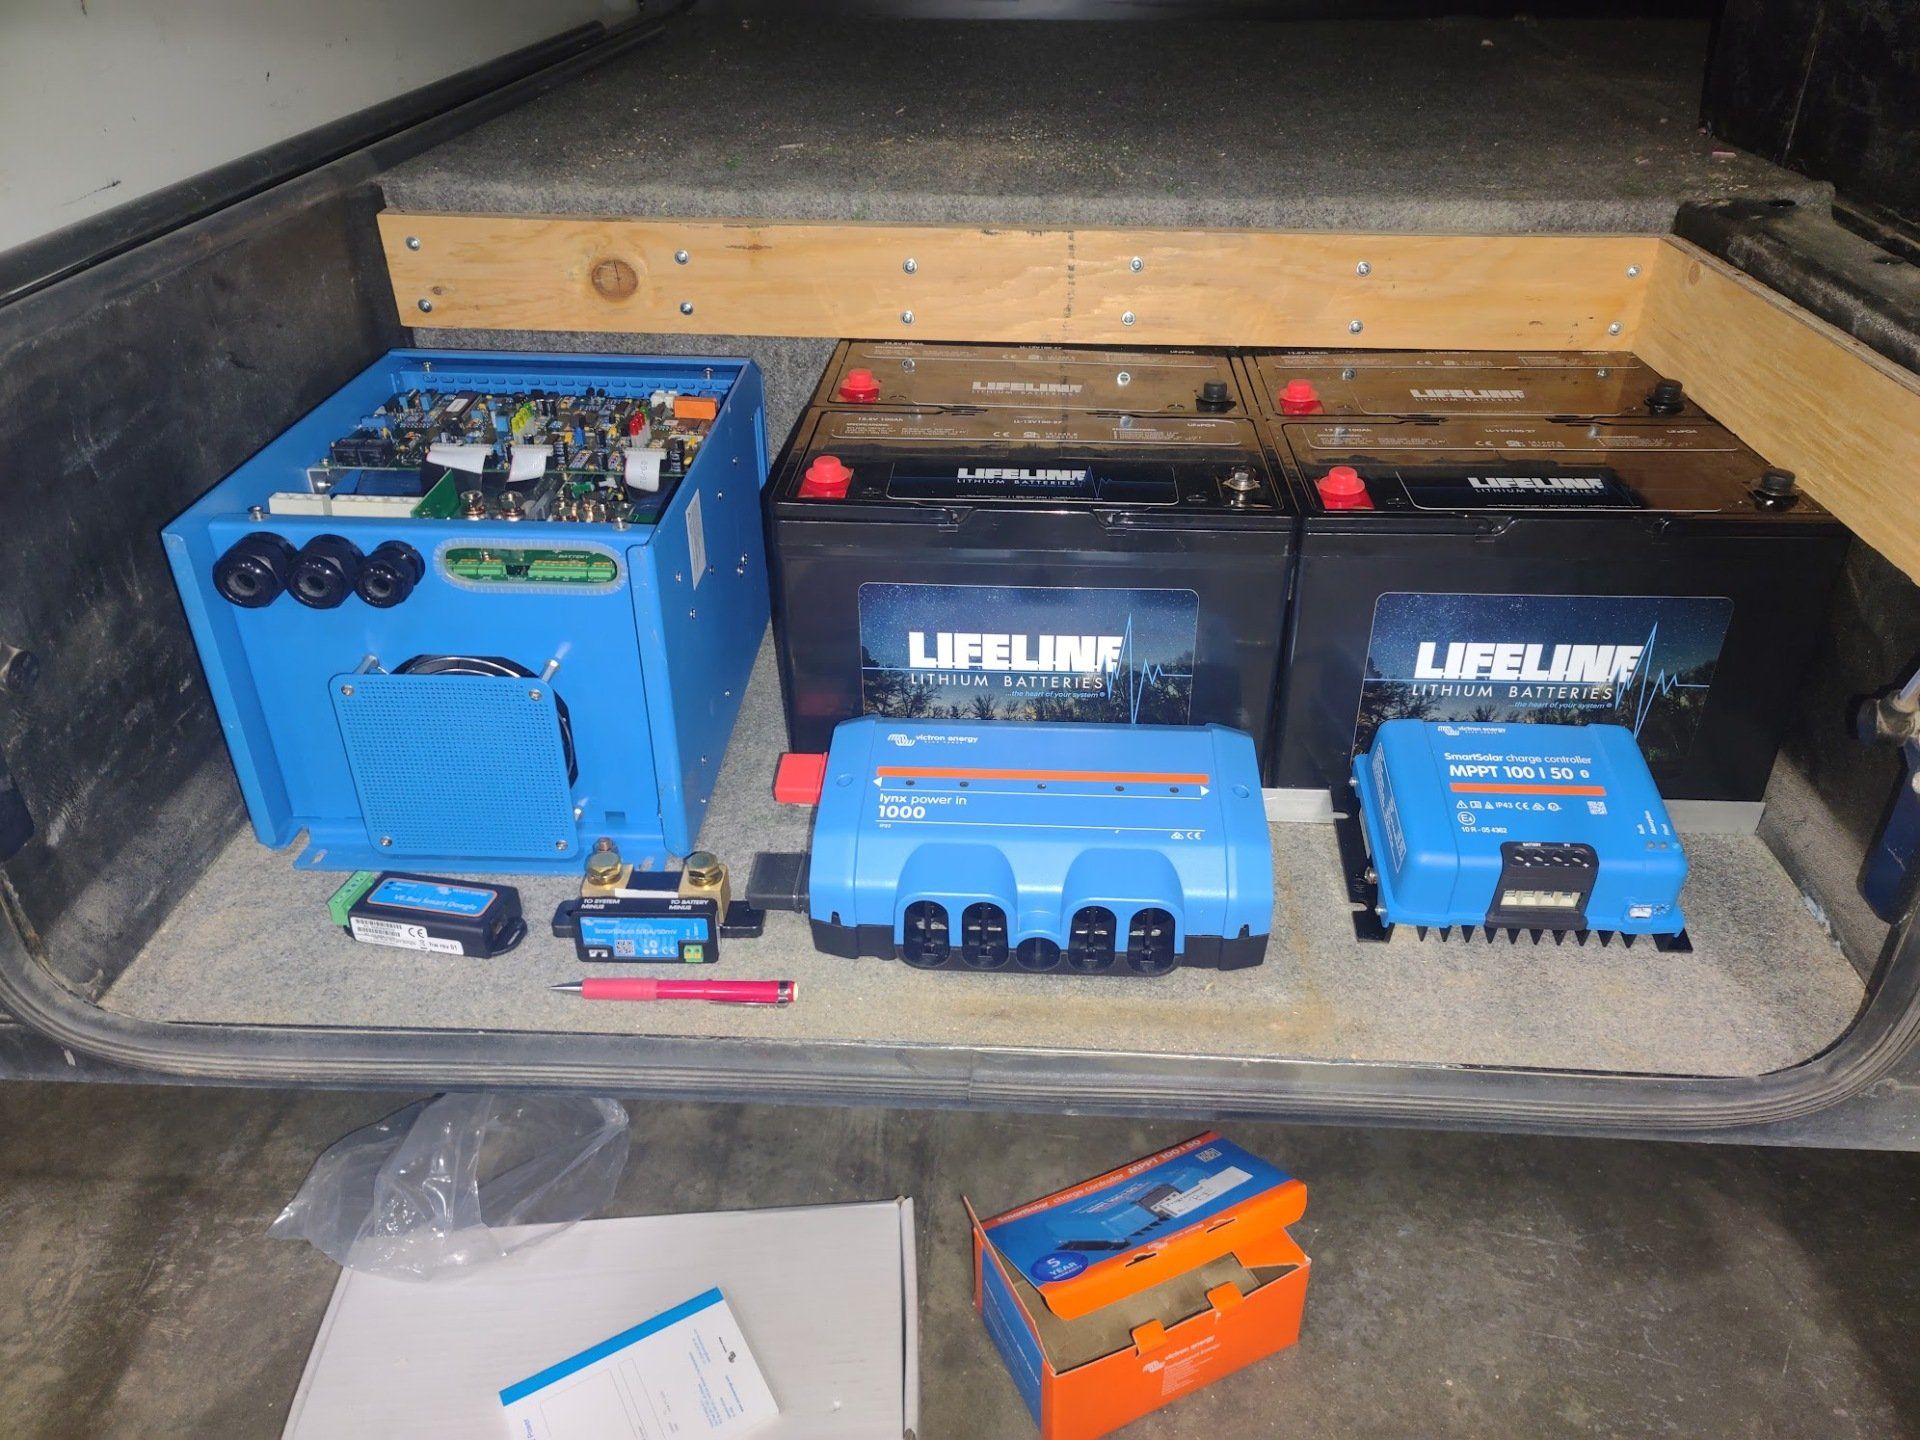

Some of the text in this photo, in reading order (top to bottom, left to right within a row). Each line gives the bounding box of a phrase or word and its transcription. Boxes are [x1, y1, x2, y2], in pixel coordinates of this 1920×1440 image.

[957, 467, 1088, 481] LIFELINE
[1467, 477, 1605, 489] LIFELINE
[908, 631, 1125, 673] LIFELINE
[1413, 641, 1646, 683] LIFELINE
[911, 673, 1104, 689] LITHIUM BATTERIES
[1411, 684, 1613, 700] LITHIUM BATTERIES
[915, 734, 946, 742] victron
[947, 736, 978, 744] energy
[1444, 752, 1592, 765] SmartSolar charge controller
[1450, 764, 1499, 778] MPPT
[1502, 765, 1536, 779] 100
[1551, 767, 1575, 780] 50
[879, 793, 967, 805] lynx power in
[1495, 801, 1514, 809] IP43
[878, 805, 926, 819] 1000
[1046, 1257, 1061, 1268] 5
[1049, 1262, 1078, 1276] YEAR
